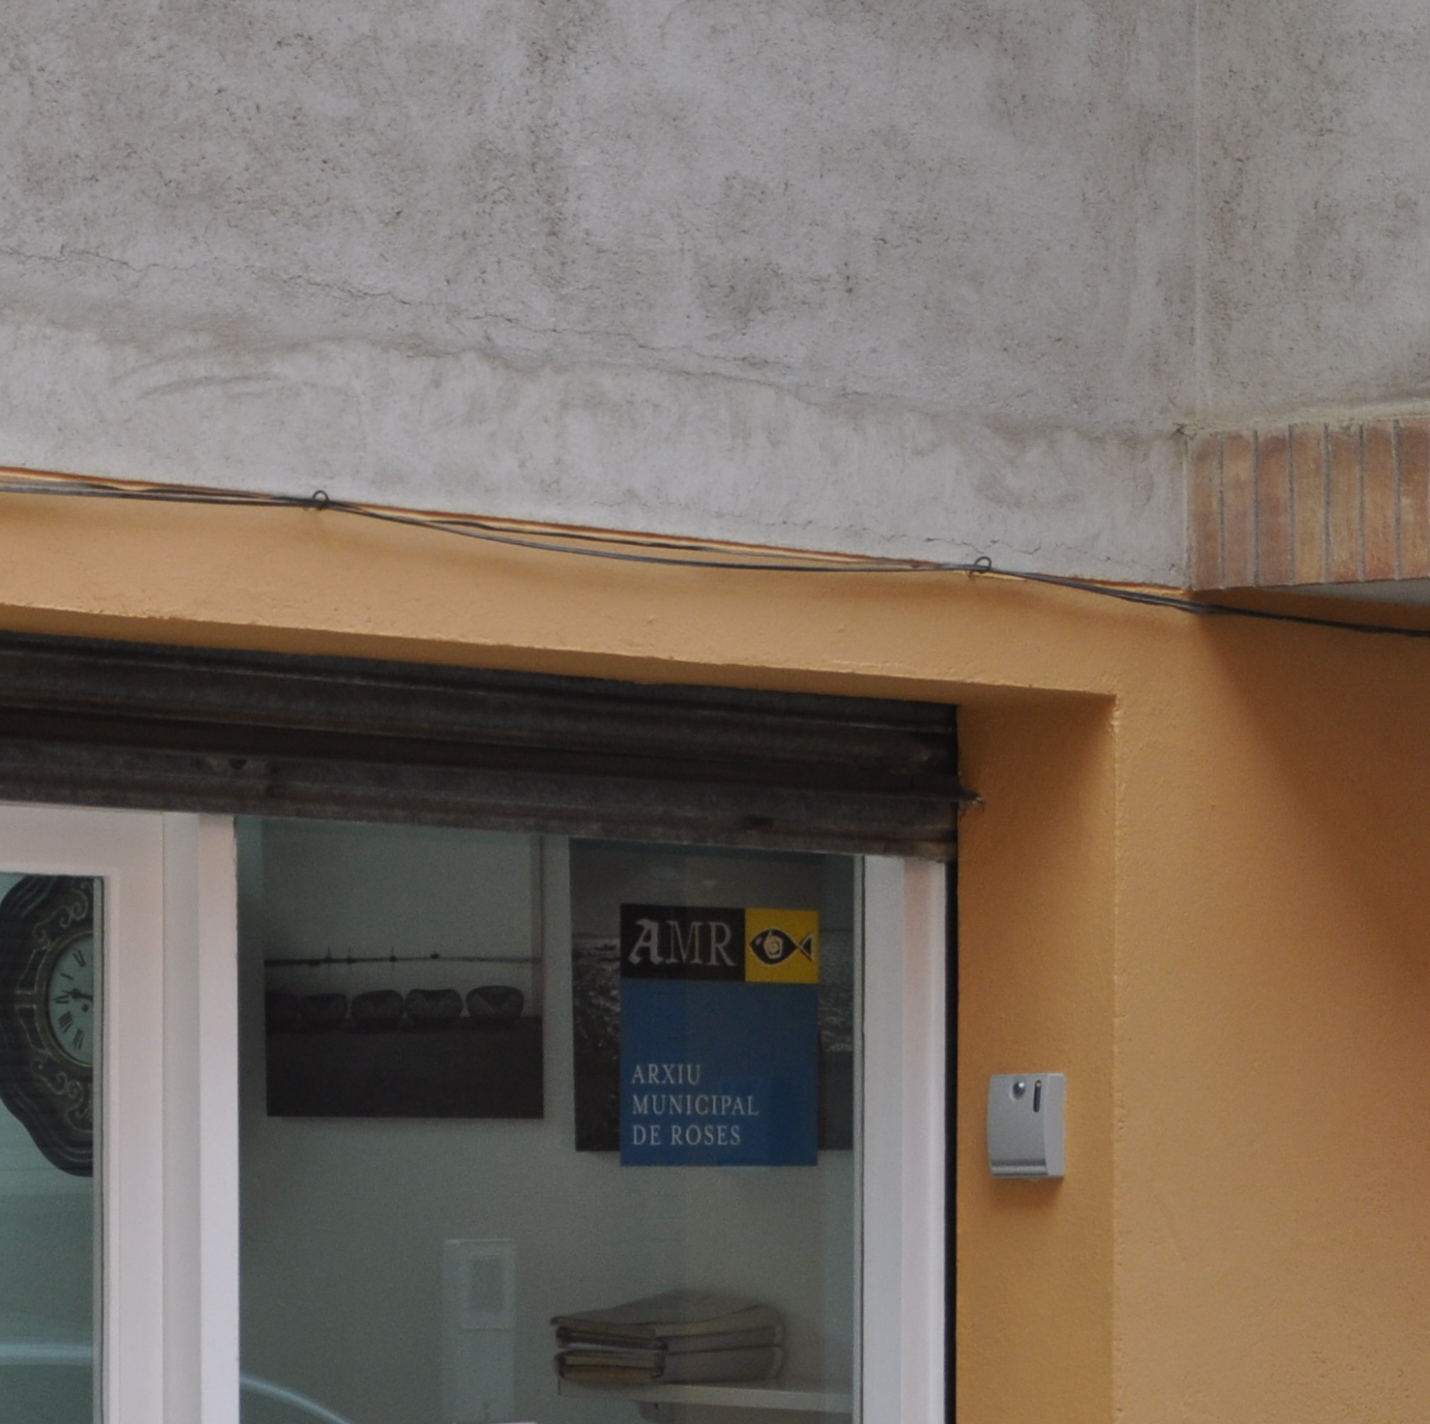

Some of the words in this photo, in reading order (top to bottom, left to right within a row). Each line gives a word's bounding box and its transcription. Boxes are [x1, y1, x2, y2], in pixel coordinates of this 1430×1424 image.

[628, 917, 736, 967] AMR
[631, 1063, 702, 1085] ARXIU
[631, 1094, 760, 1117] MUNICIPAL
[632, 1124, 663, 1146] DE
[670, 1124, 741, 1146] ROSES
